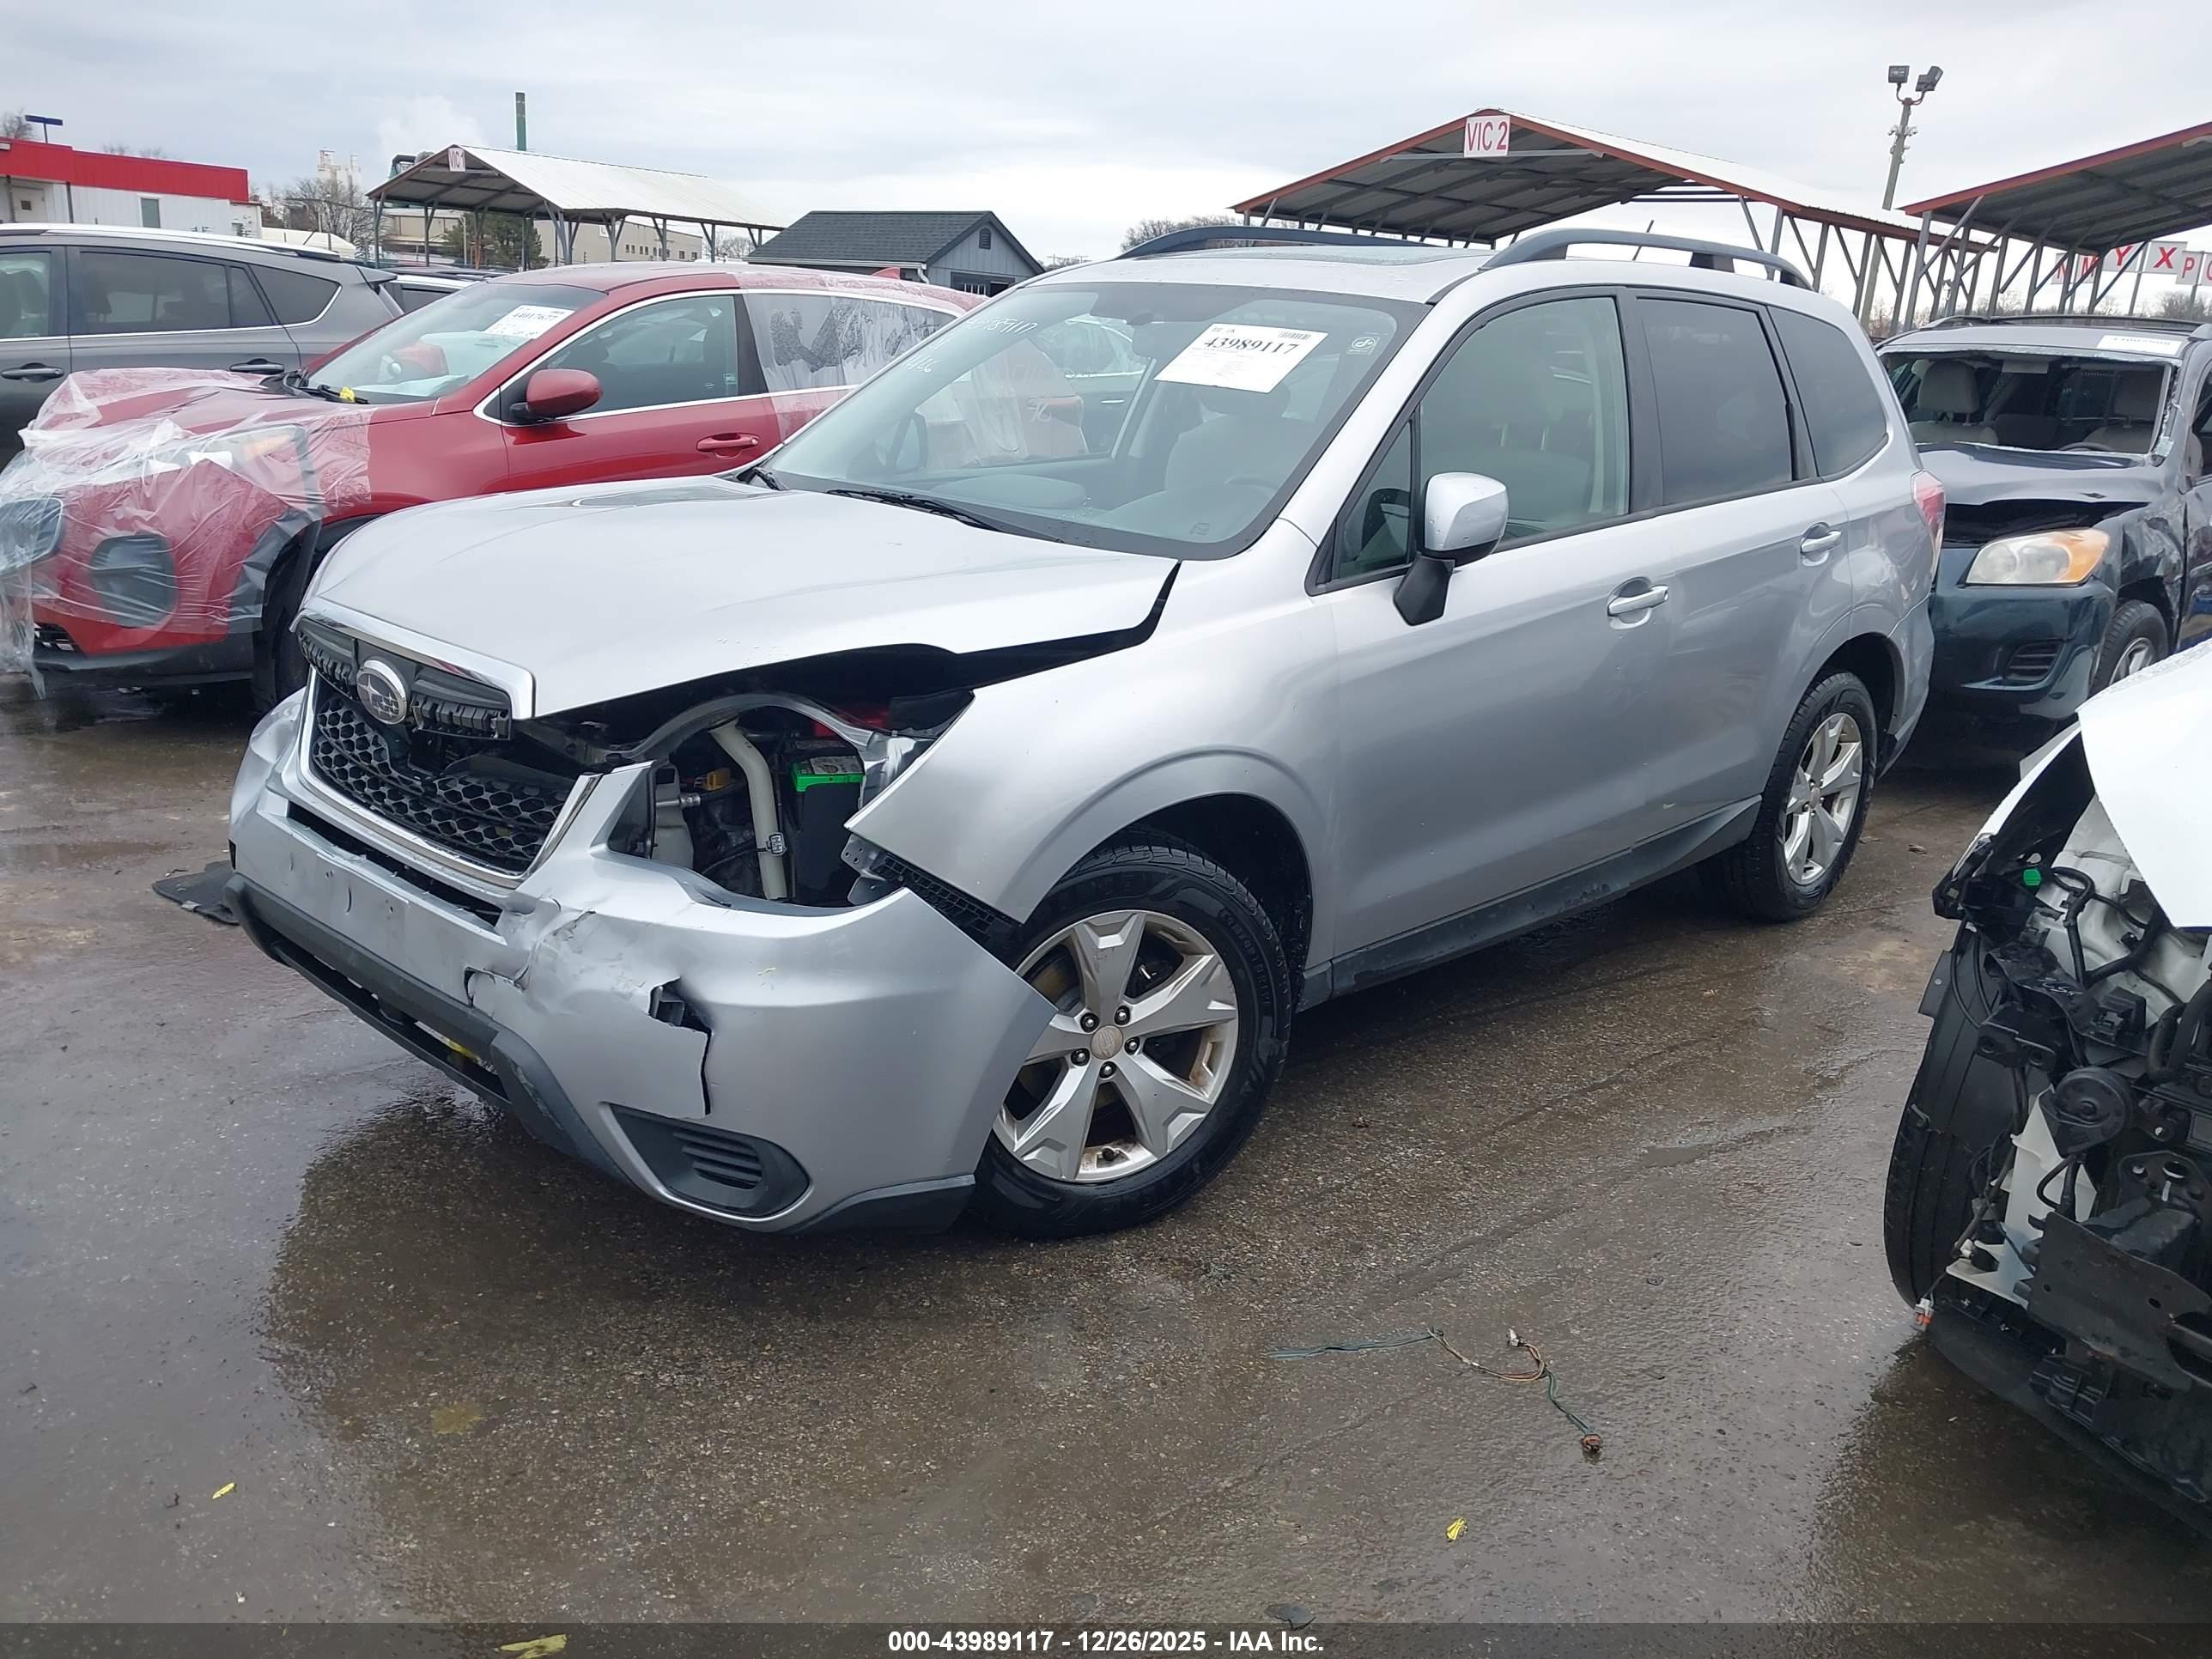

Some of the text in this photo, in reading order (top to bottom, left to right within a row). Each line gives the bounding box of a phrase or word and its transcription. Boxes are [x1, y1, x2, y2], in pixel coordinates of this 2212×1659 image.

[1468, 121, 1508, 151] VIC 2
[2115, 246, 2133, 266] Y
[2153, 246, 2178, 269] X
[2182, 257, 2195, 278] P
[1204, 337, 1299, 355] 43989117
